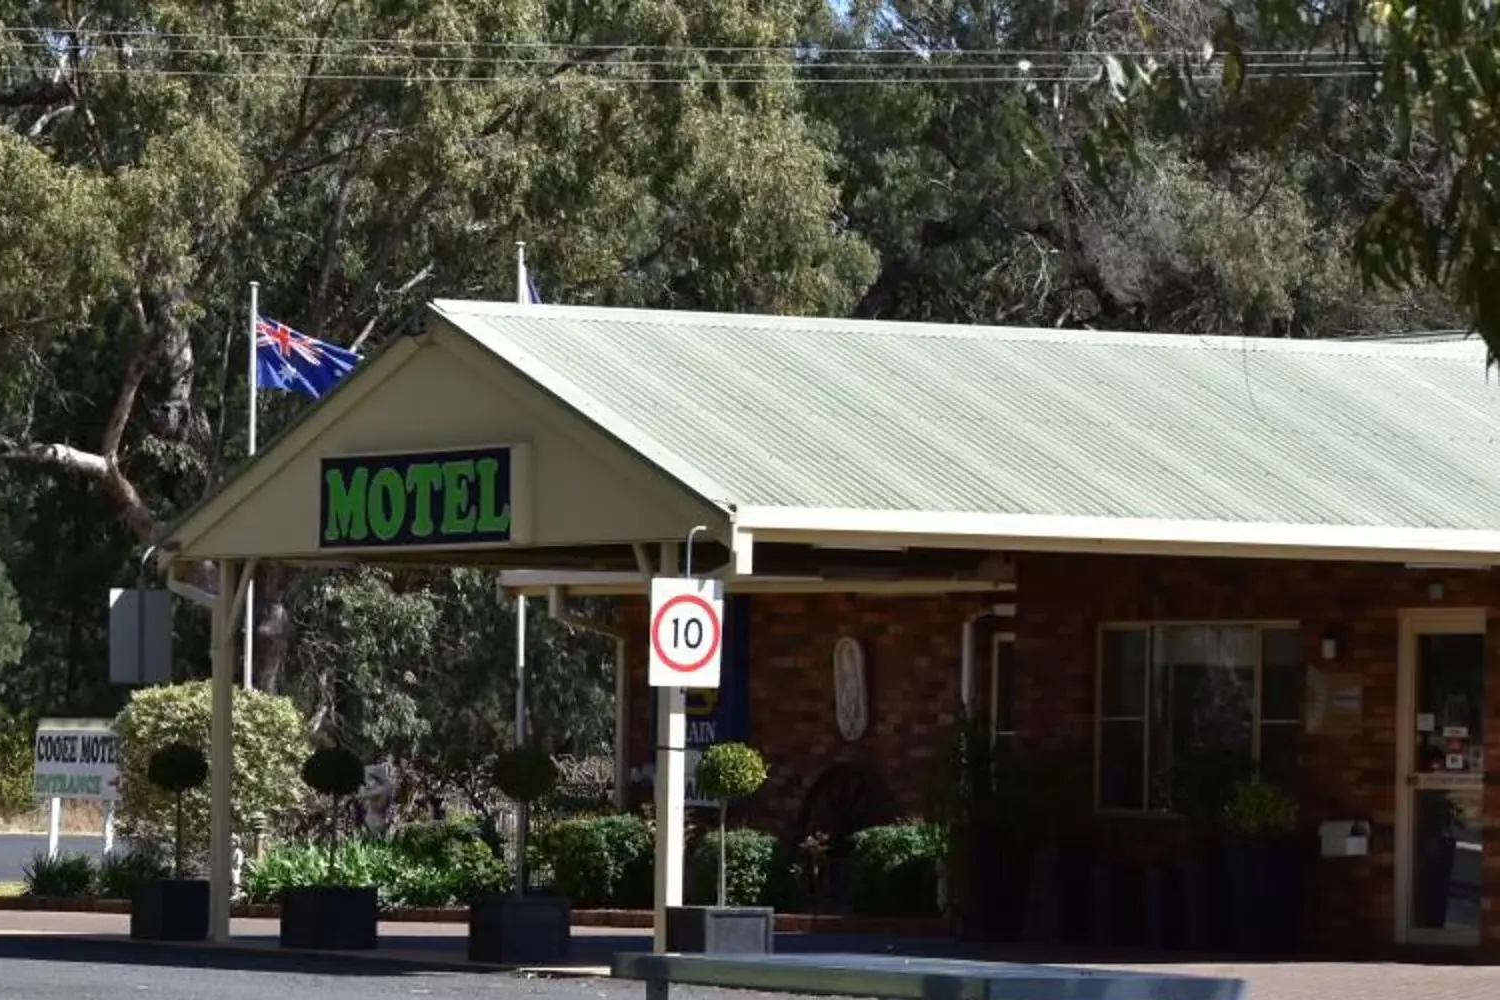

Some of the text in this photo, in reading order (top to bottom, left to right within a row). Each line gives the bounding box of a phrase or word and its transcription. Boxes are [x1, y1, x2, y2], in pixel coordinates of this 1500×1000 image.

[324, 457, 511, 541] MOTEL
[671, 617, 703, 649] 10
[686, 721, 716, 742] AIN
[38, 736, 77, 762] COOEE
